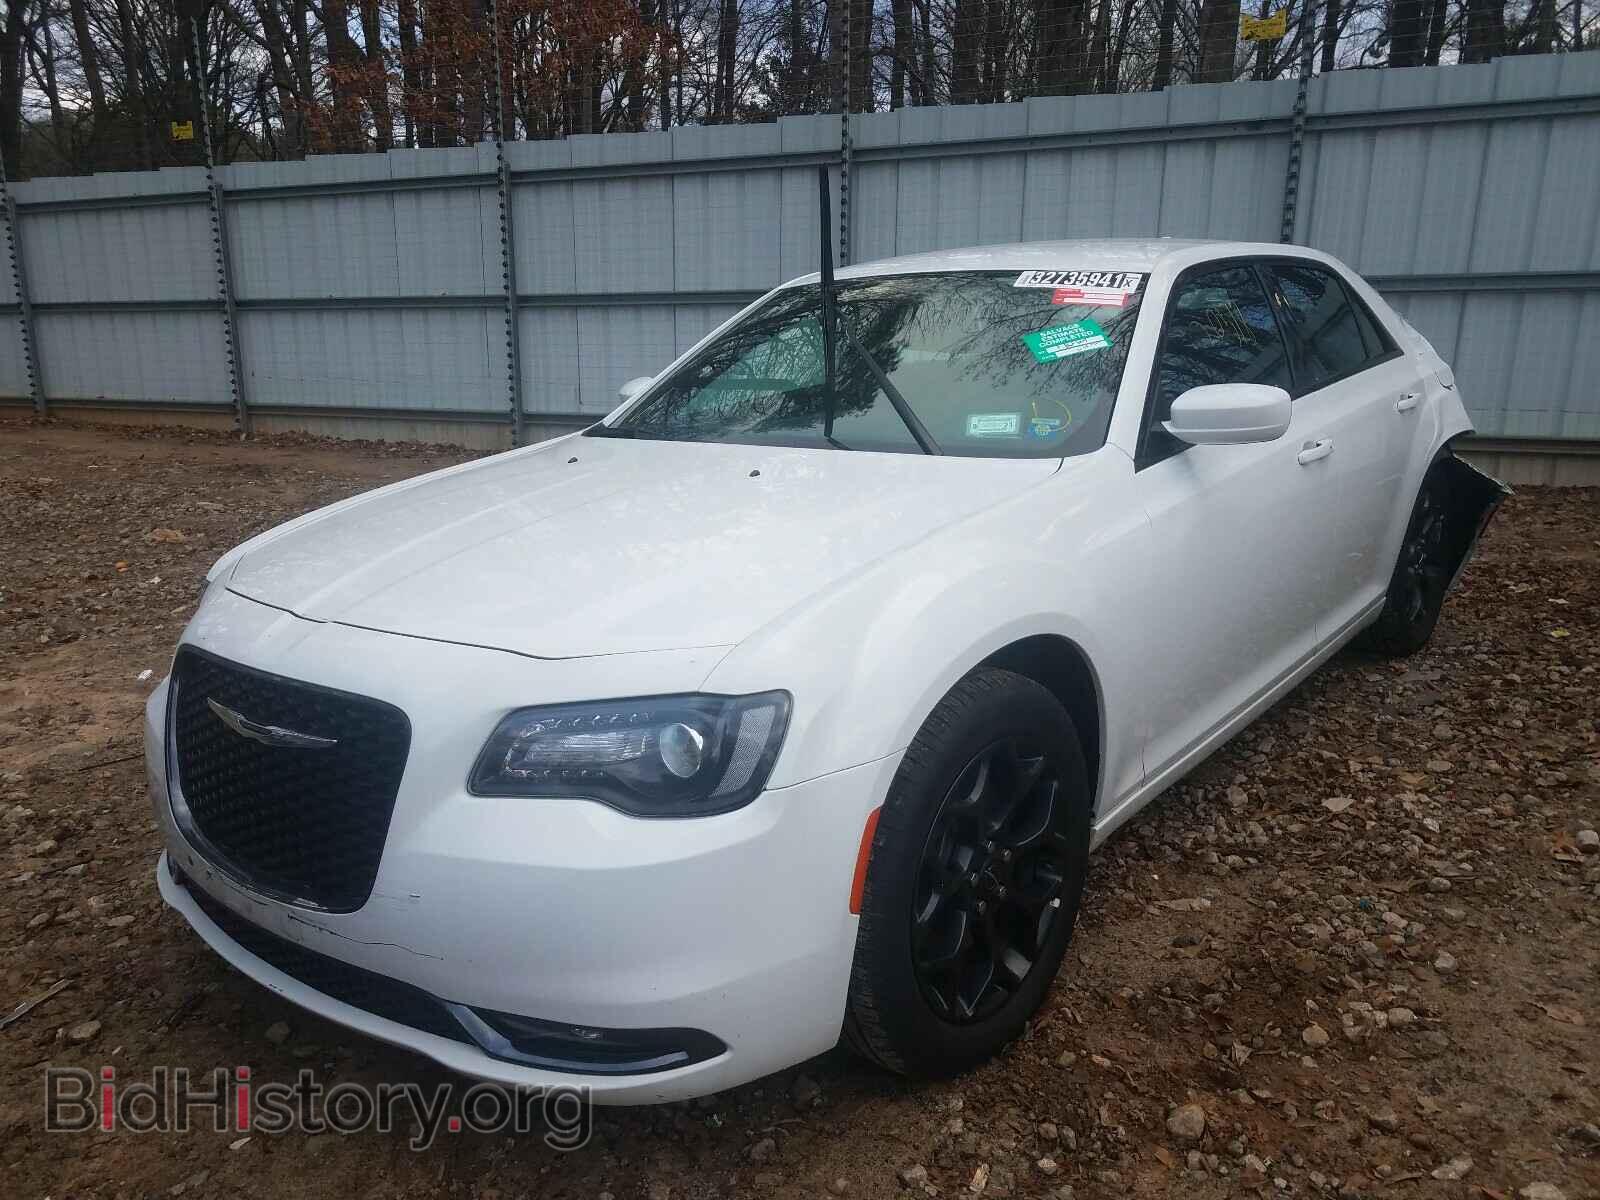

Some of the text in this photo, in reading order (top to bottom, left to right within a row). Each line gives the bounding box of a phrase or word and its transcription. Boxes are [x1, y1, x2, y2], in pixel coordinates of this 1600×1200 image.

[1030, 271, 1123, 288] 32735941
[1040, 324, 1080, 337] SALVAGE
[1040, 328, 1085, 342] ESTIMATE
[1038, 331, 1094, 348] COMPLETED
